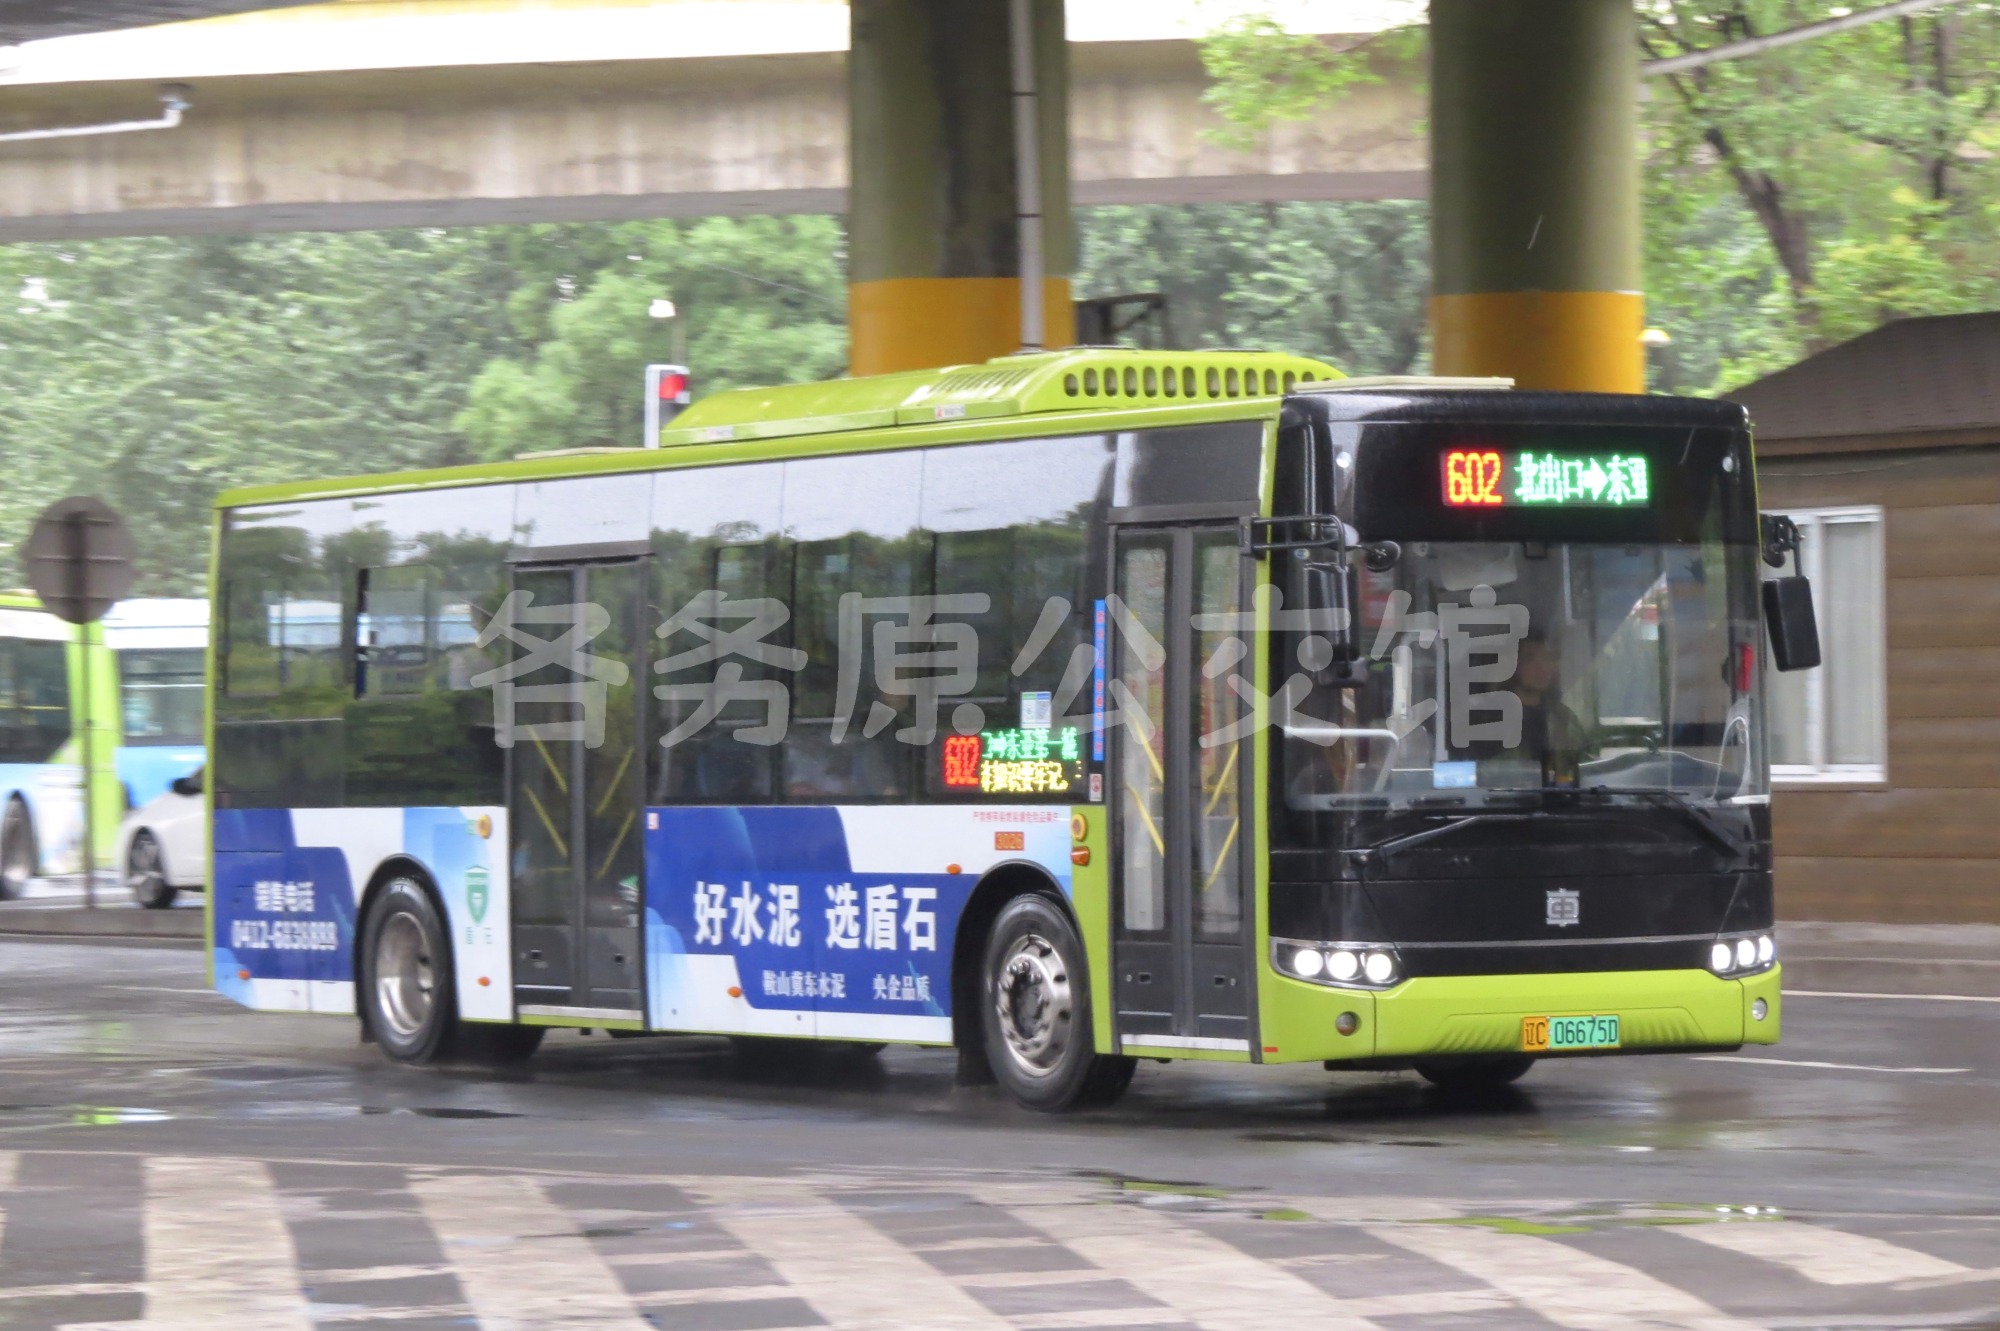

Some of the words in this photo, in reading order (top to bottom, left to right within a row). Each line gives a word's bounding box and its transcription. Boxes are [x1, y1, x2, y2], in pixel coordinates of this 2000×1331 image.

[1447, 453, 1502, 502] 602
[694, 880, 801, 947] 好水泥
[825, 882, 937, 951] 选盾石
[872, 973, 931, 1001] 央企品质
